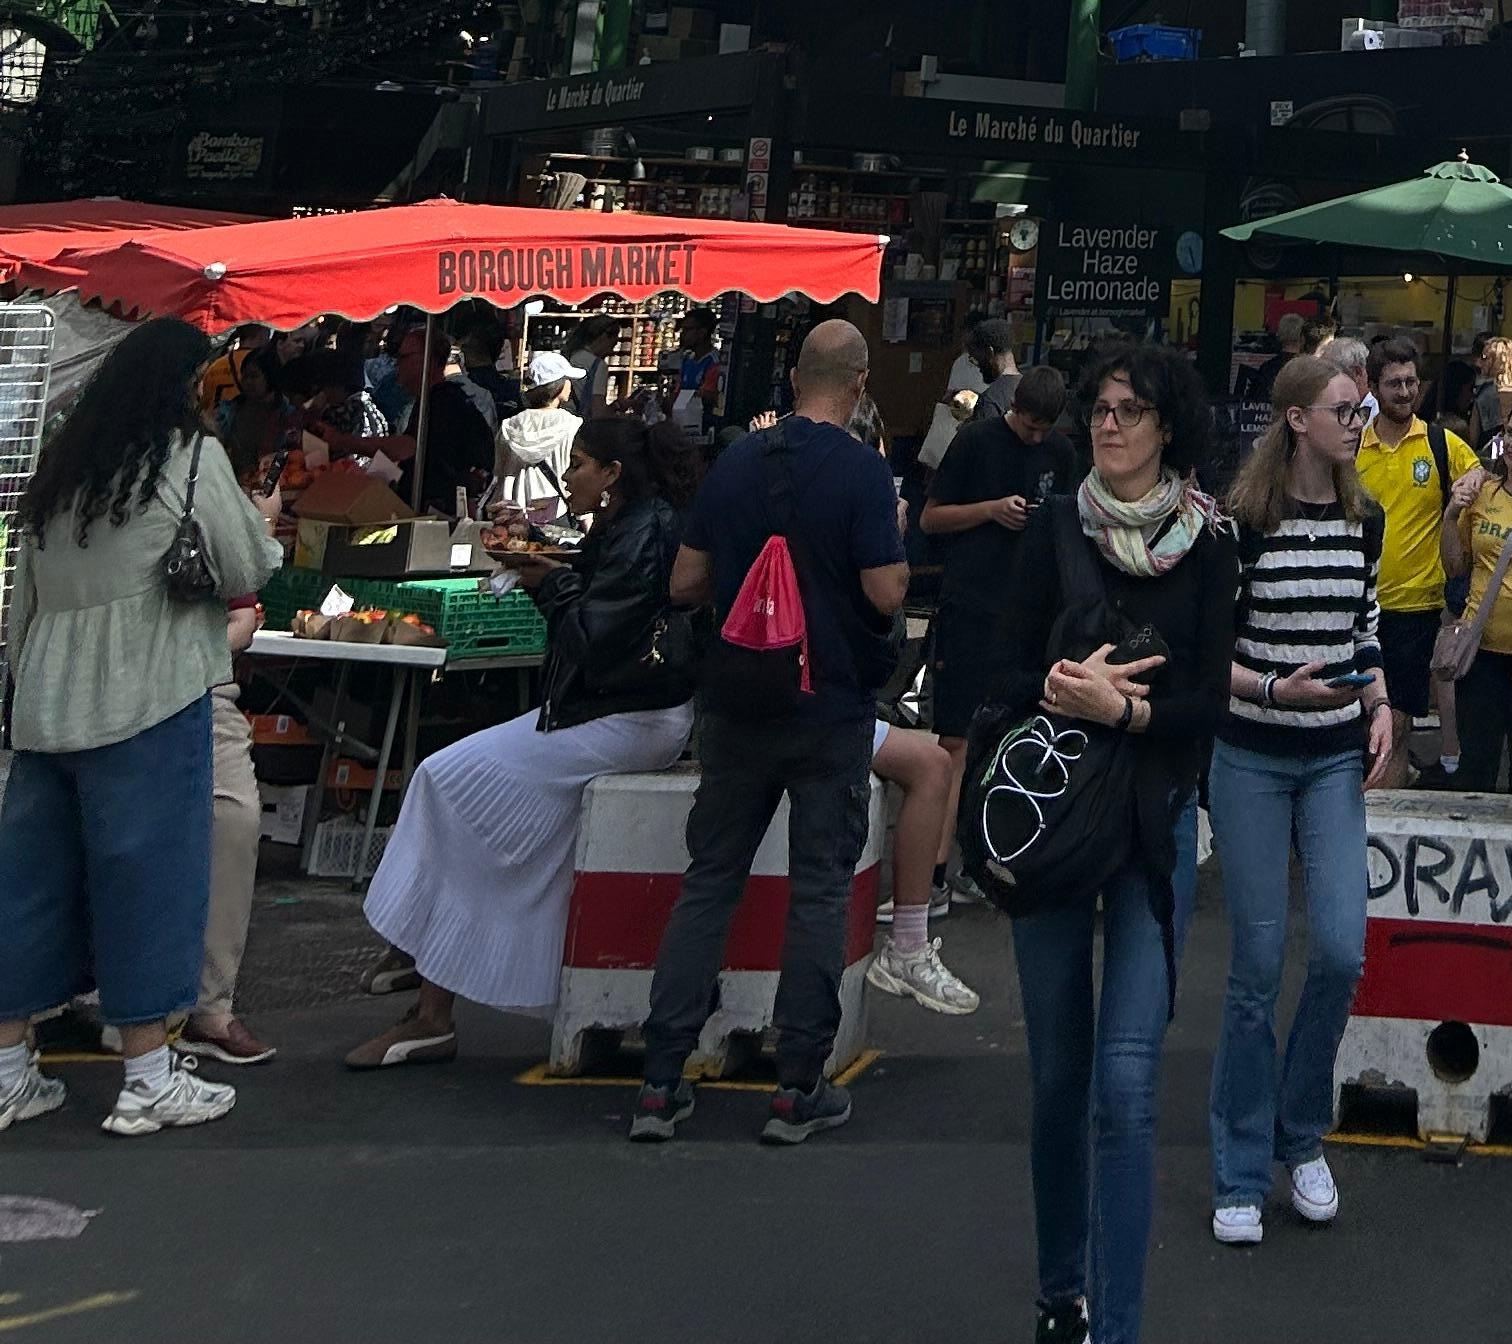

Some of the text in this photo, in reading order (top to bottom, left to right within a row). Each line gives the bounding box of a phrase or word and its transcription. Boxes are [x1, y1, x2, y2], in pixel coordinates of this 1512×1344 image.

[546, 88, 557, 111] Le
[605, 76, 645, 107] Quartier
[949, 111, 1141, 149] Le Marché du Quartier
[1058, 222, 1158, 249] Lavender
[438, 244, 697, 294] BOROUGH MARKET
[1083, 250, 1138, 274] Haze
[1047, 275, 1160, 301] Lemonade
[1242, 401, 1270, 411] LAVEN
[1255, 413, 1273, 422] HAZ
